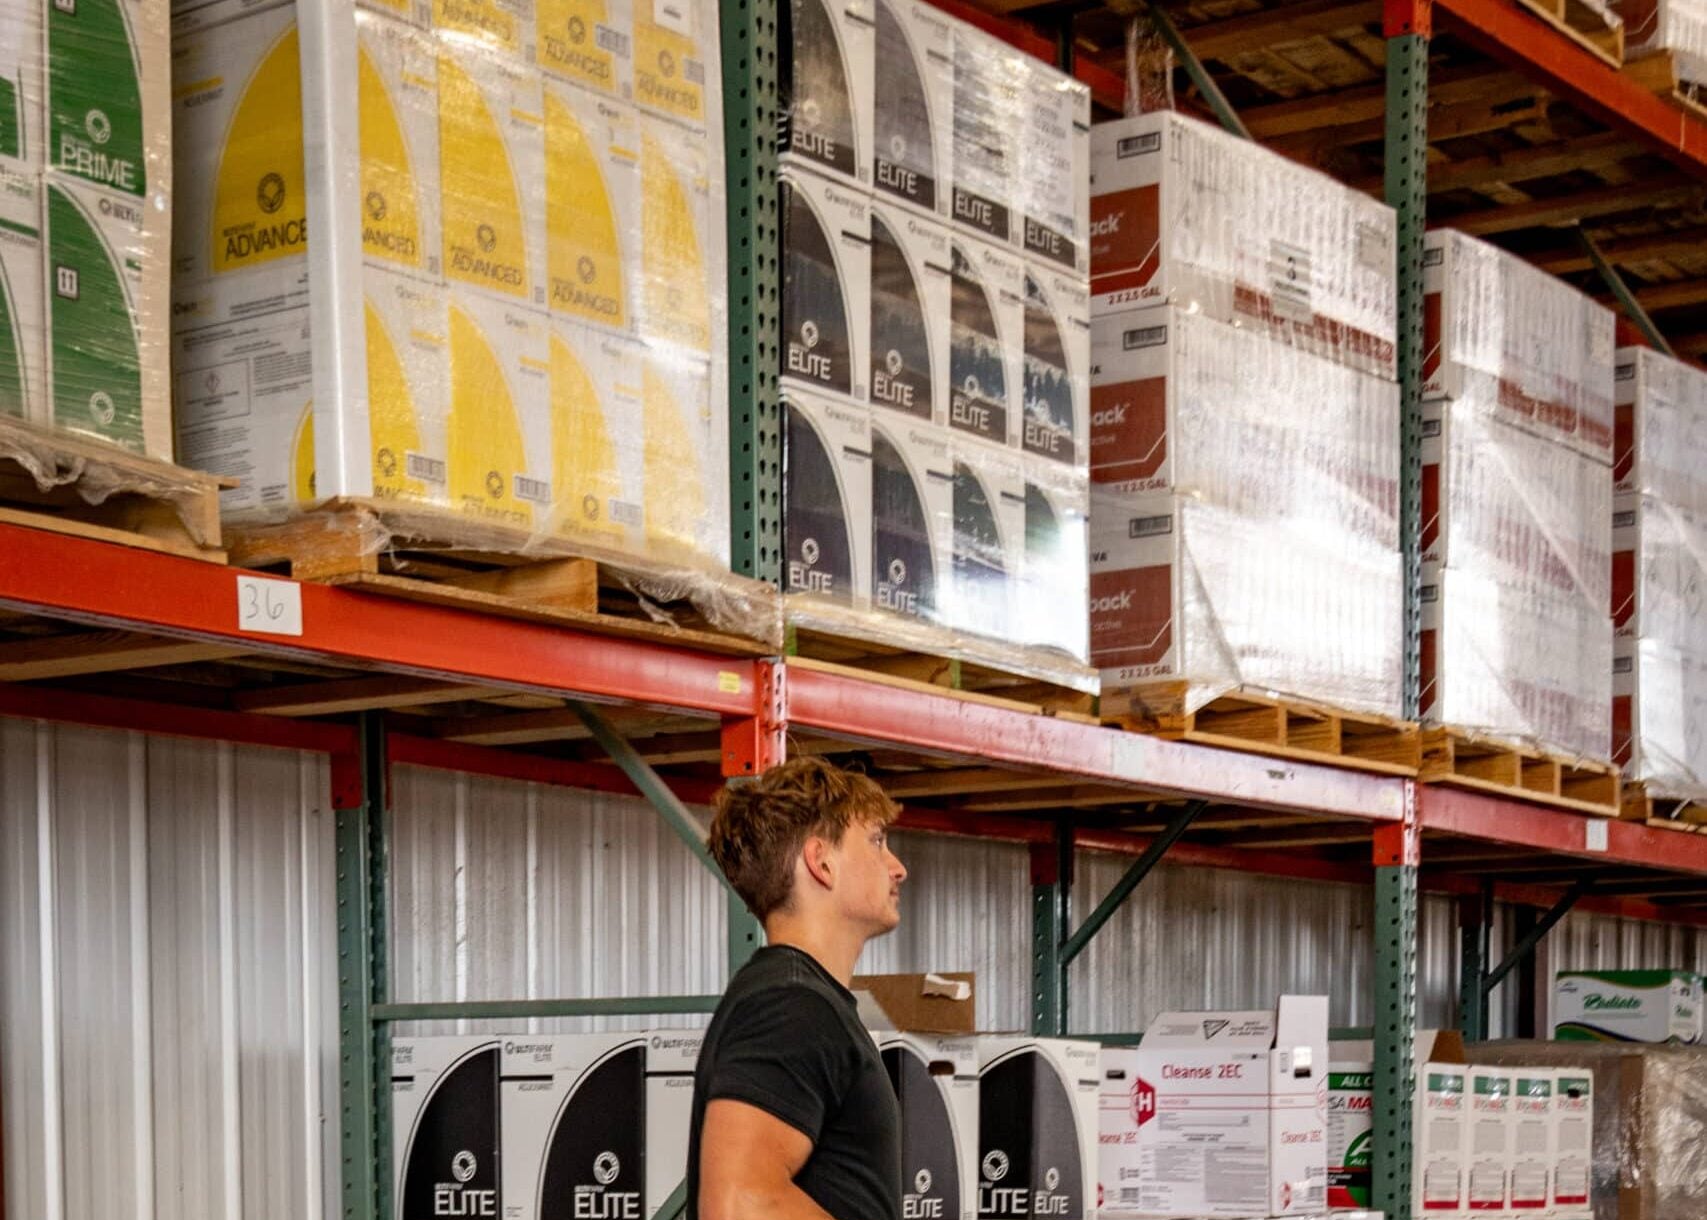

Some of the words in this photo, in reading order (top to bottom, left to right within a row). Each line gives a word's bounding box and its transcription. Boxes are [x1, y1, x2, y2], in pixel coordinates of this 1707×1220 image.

[791, 131, 836, 160] ELITE
[59, 143, 137, 191] PRIME
[878, 159, 919, 195] ELITE
[955, 194, 994, 226] ELITE
[225, 217, 308, 261] ADVANCE
[1026, 223, 1061, 256] ELITE
[1090, 213, 1121, 237] ack
[362, 229, 416, 256] VANCED
[452, 251, 523, 287] ADVANCED
[553, 282, 620, 317] ADVANCED
[788, 347, 832, 381] ELITE
[874, 377, 915, 408] ELITE
[952, 401, 991, 431] ELITE
[1092, 403, 1126, 427] ack
[1026, 423, 1060, 452] ELITE
[789, 565, 833, 595] ELITE
[244, 583, 285, 621] 36
[877, 588, 918, 615] ELITE
[1090, 589, 1132, 613] pack
[1161, 1063, 1212, 1080] Cleanse
[1217, 1063, 1243, 1079] 2EC
[435, 1189, 497, 1216] ELITE
[574, 1191, 641, 1220] ELITE
[903, 1197, 944, 1220] ELITE
[978, 1187, 1030, 1214] LITE
[1034, 1194, 1070, 1215] ELITE
